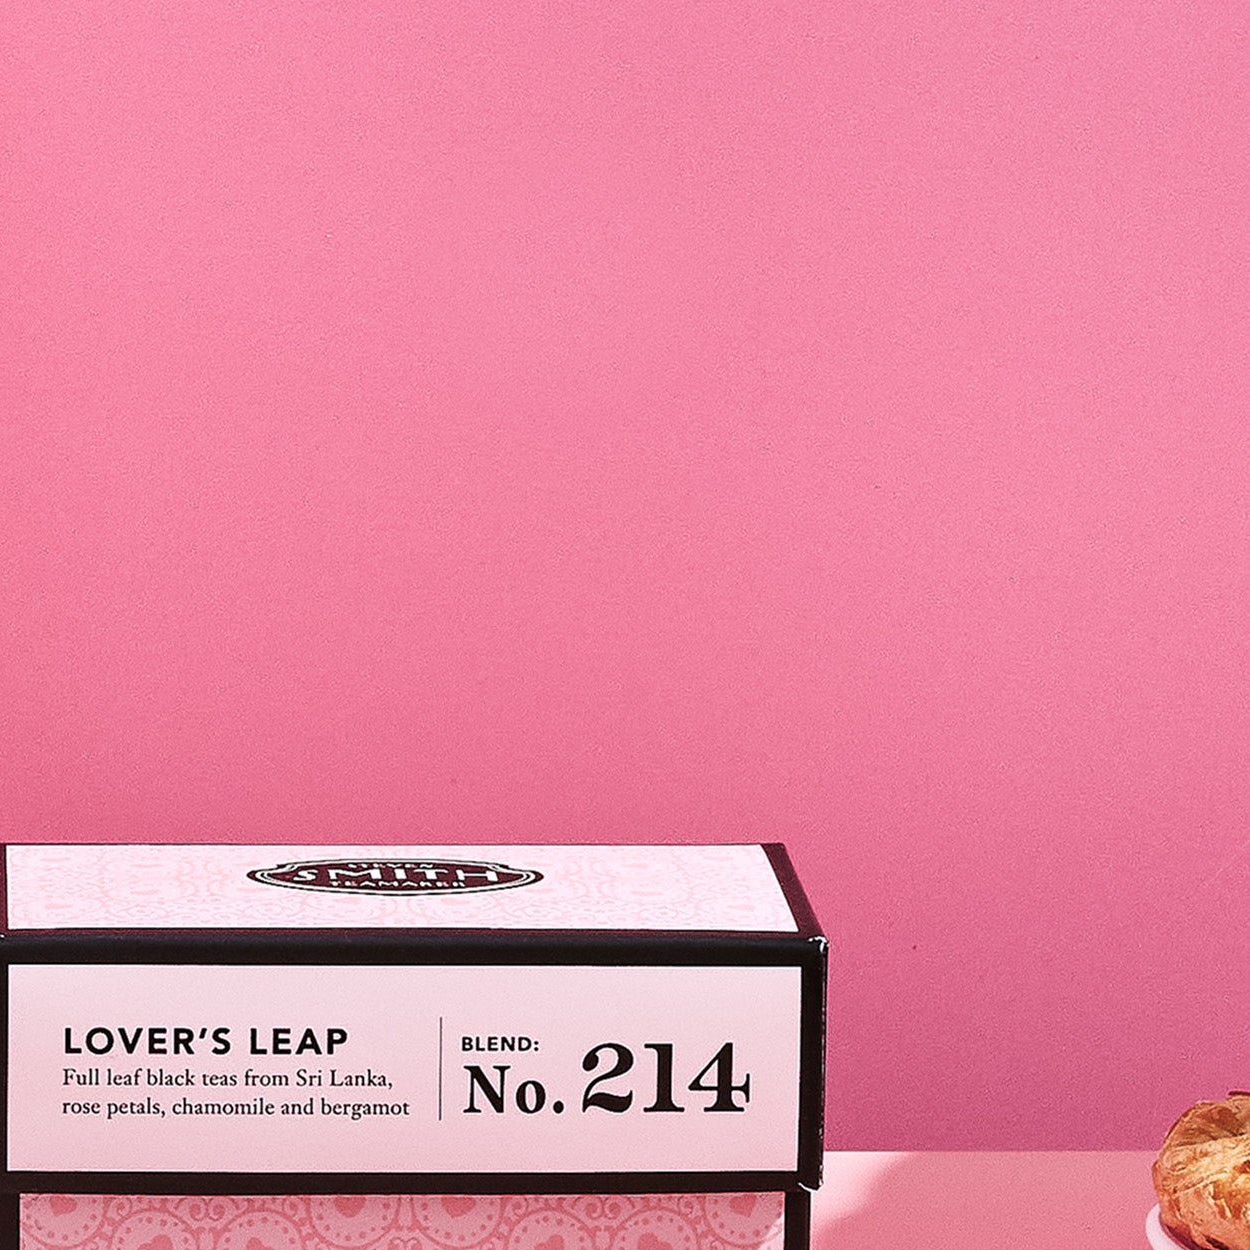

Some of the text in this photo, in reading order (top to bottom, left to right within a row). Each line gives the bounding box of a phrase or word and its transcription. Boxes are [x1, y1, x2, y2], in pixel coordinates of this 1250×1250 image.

[293, 868, 499, 882] SMITH
[63, 1027, 348, 1055] LOVER'S LEAP
[461, 1036, 540, 1052] BLEND:
[62, 1067, 394, 1090] Full leaf black teas from Sri Lanka,
[463, 1042, 750, 1115] No. 214
[62, 1096, 410, 1121] rose petals, chamomile and bergamot
